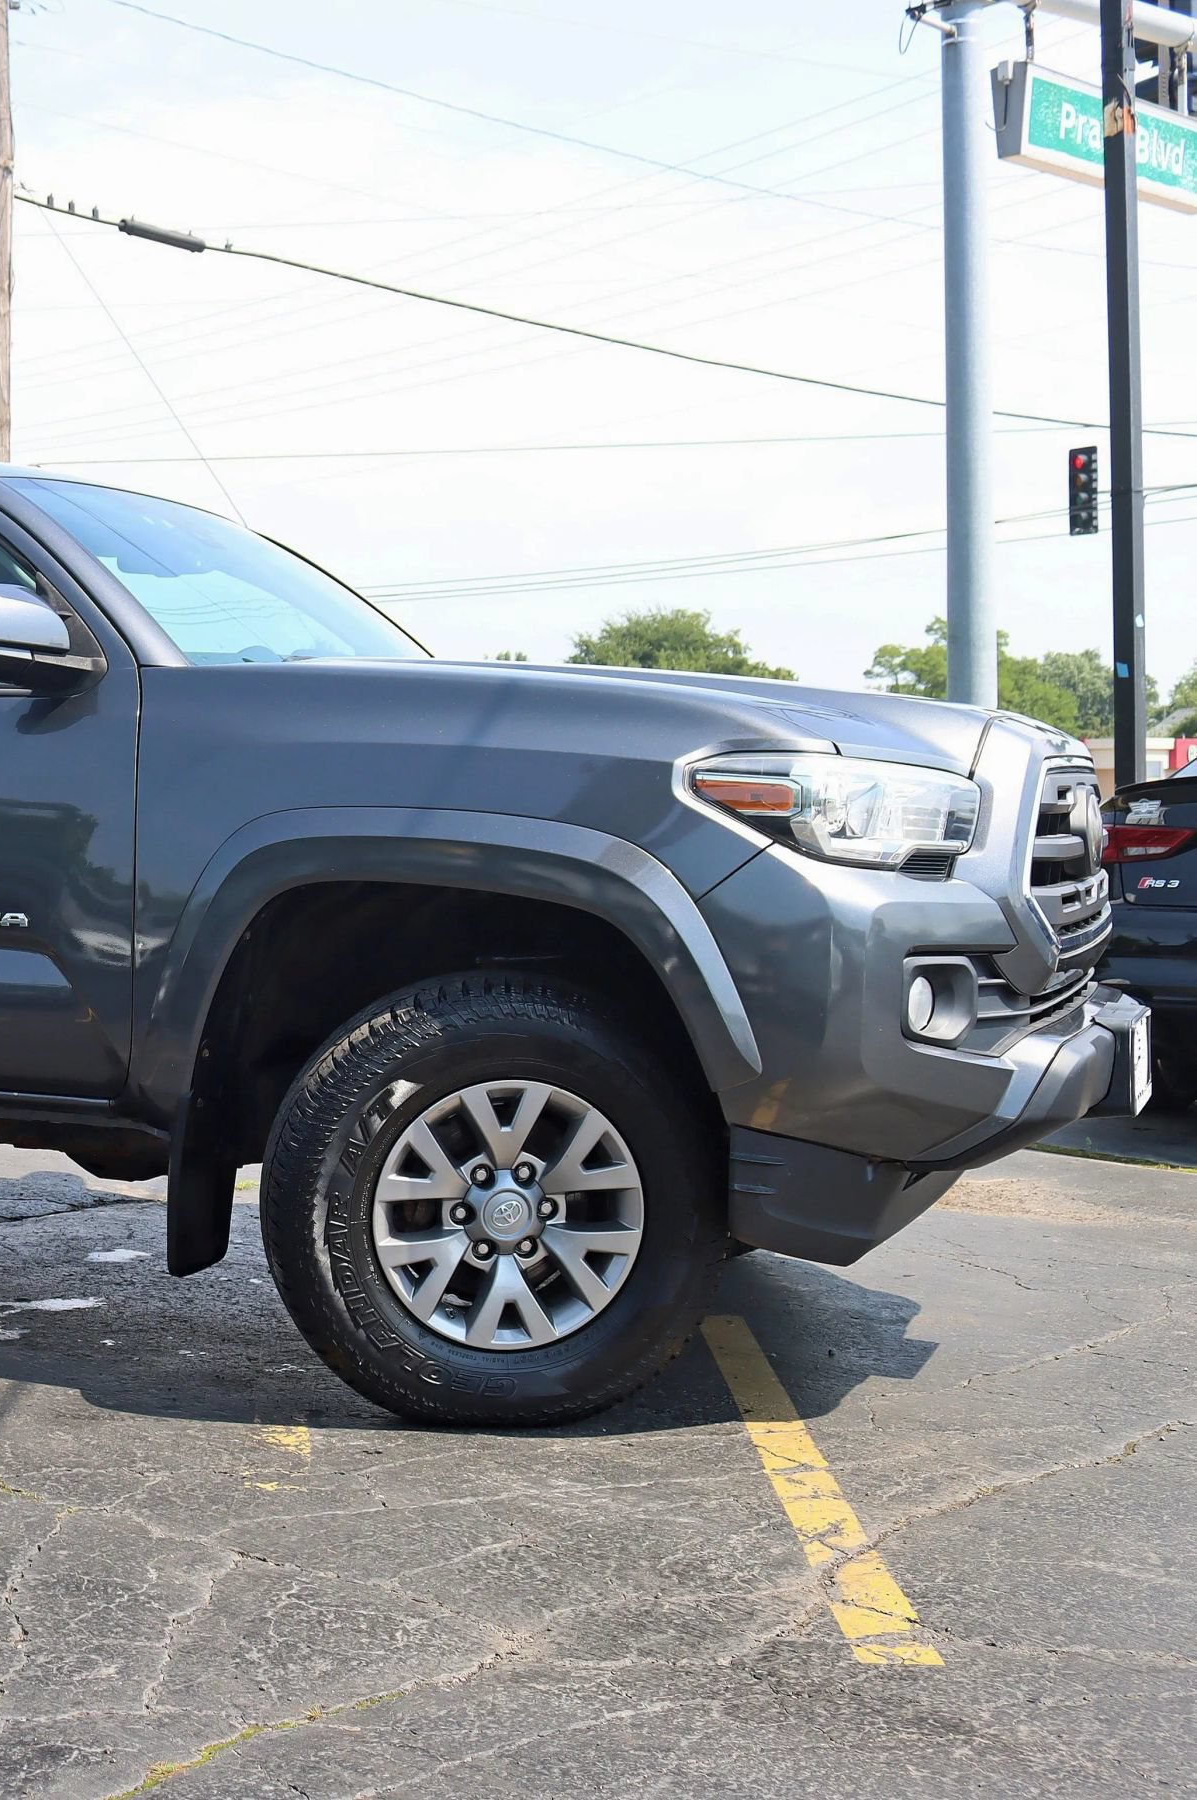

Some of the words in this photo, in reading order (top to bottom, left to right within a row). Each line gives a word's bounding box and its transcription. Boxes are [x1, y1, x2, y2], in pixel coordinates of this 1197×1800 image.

[1135, 124, 1186, 177] Blvd
[1167, 879, 1180, 888] 3
[326, 1190, 518, 1397] GEOLANDAR
